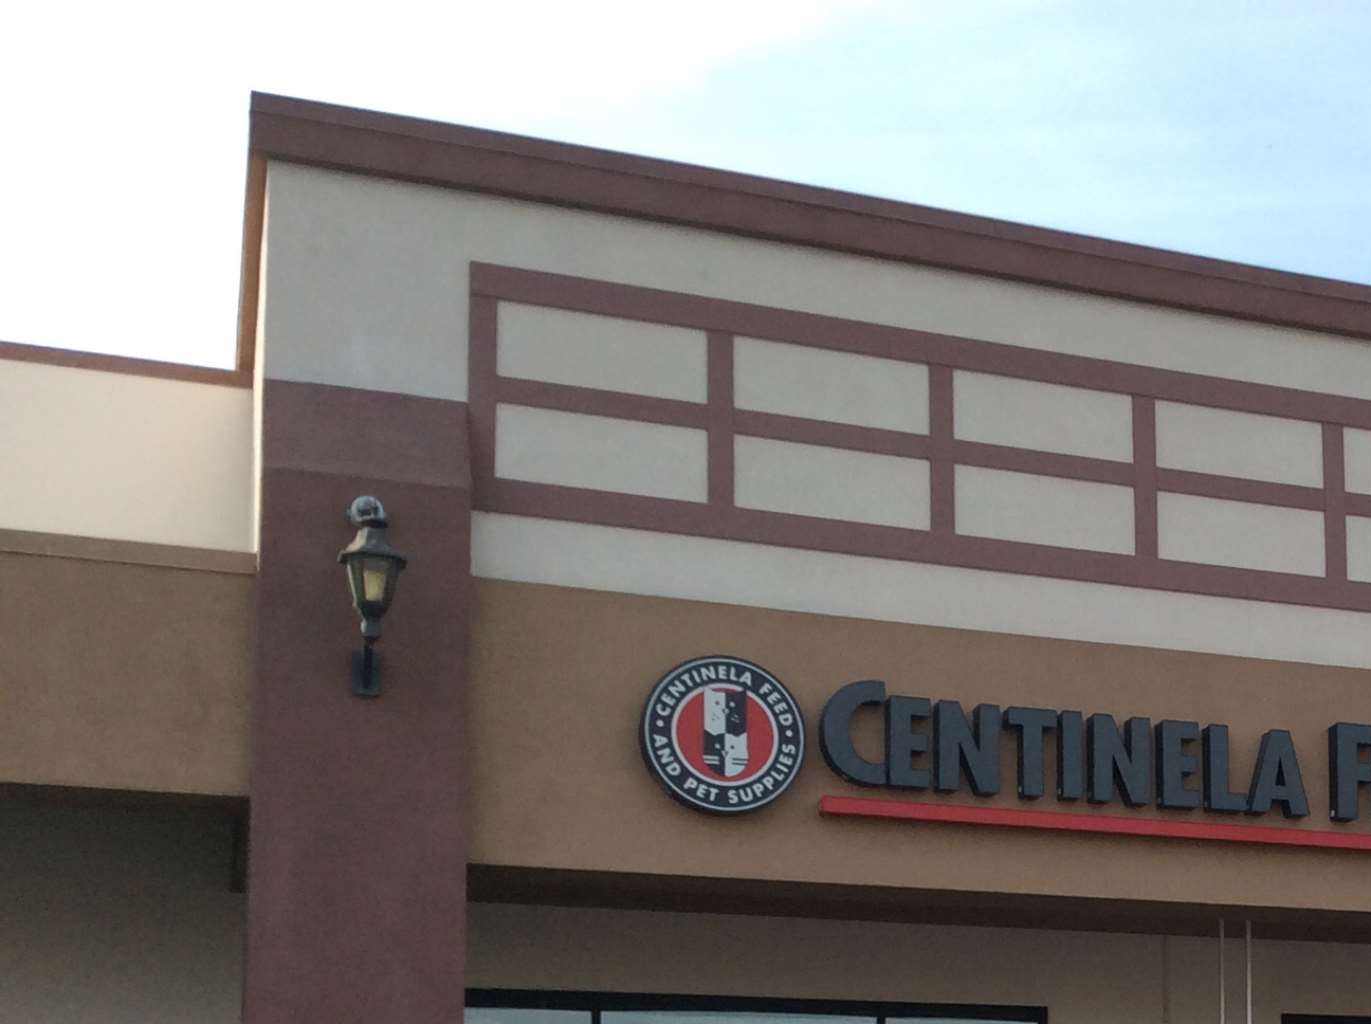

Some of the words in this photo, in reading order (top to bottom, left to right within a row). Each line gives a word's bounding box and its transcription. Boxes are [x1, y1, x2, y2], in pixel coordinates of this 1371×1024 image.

[655, 665, 753, 716] CENTINELA
[758, 683, 793, 726] FEED
[653, 734, 681, 776] AND
[683, 777, 719, 801] PET
[728, 744, 796, 803] SUPPLIES
[819, 680, 1310, 818] CENTINELA
